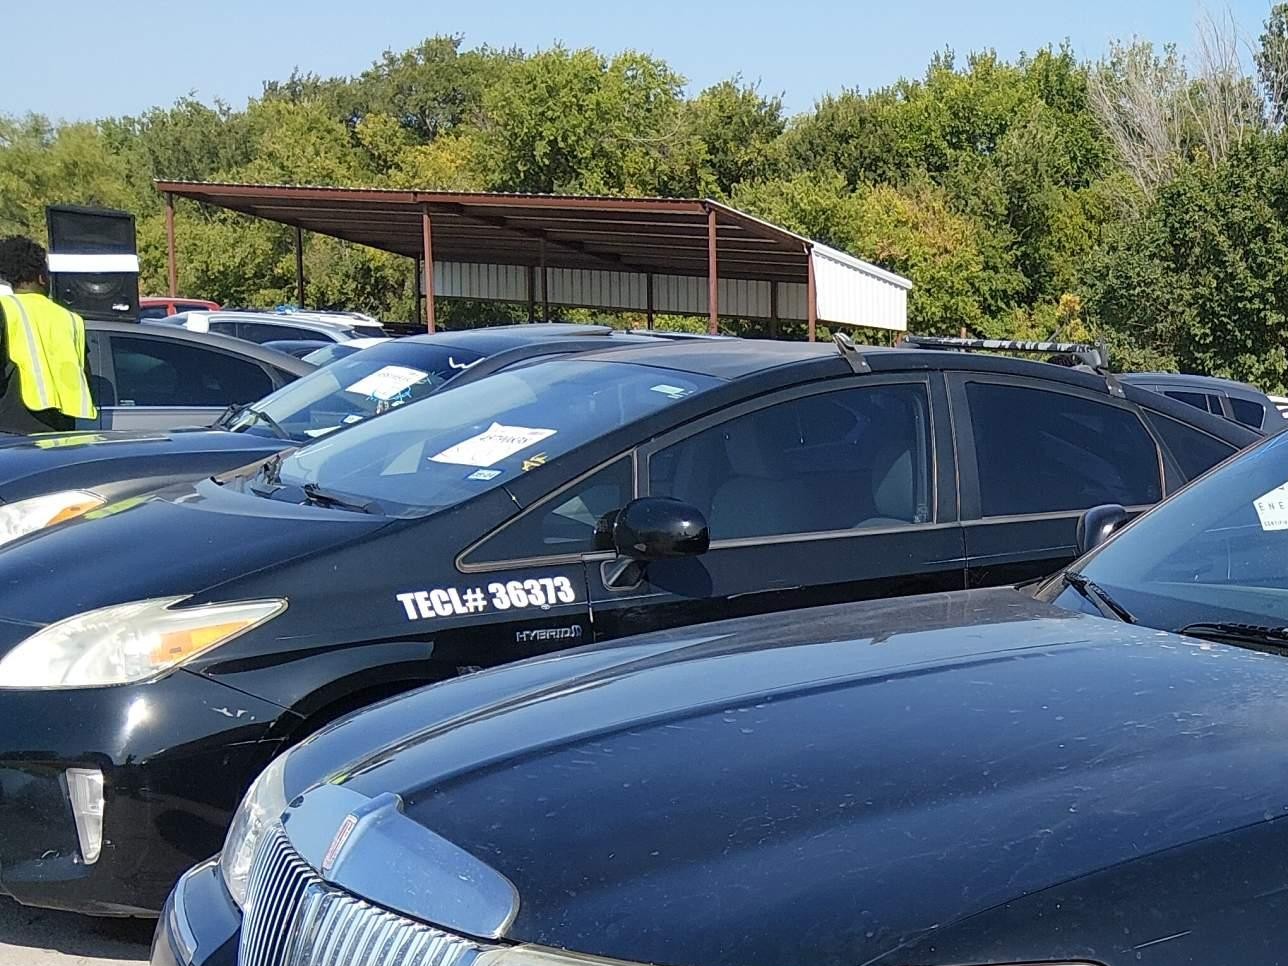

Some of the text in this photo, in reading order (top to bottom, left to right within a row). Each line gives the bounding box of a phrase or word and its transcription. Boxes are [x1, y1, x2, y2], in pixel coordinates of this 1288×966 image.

[396, 575, 576, 621] TECL# 36373
[516, 627, 575, 643] HYBRID
